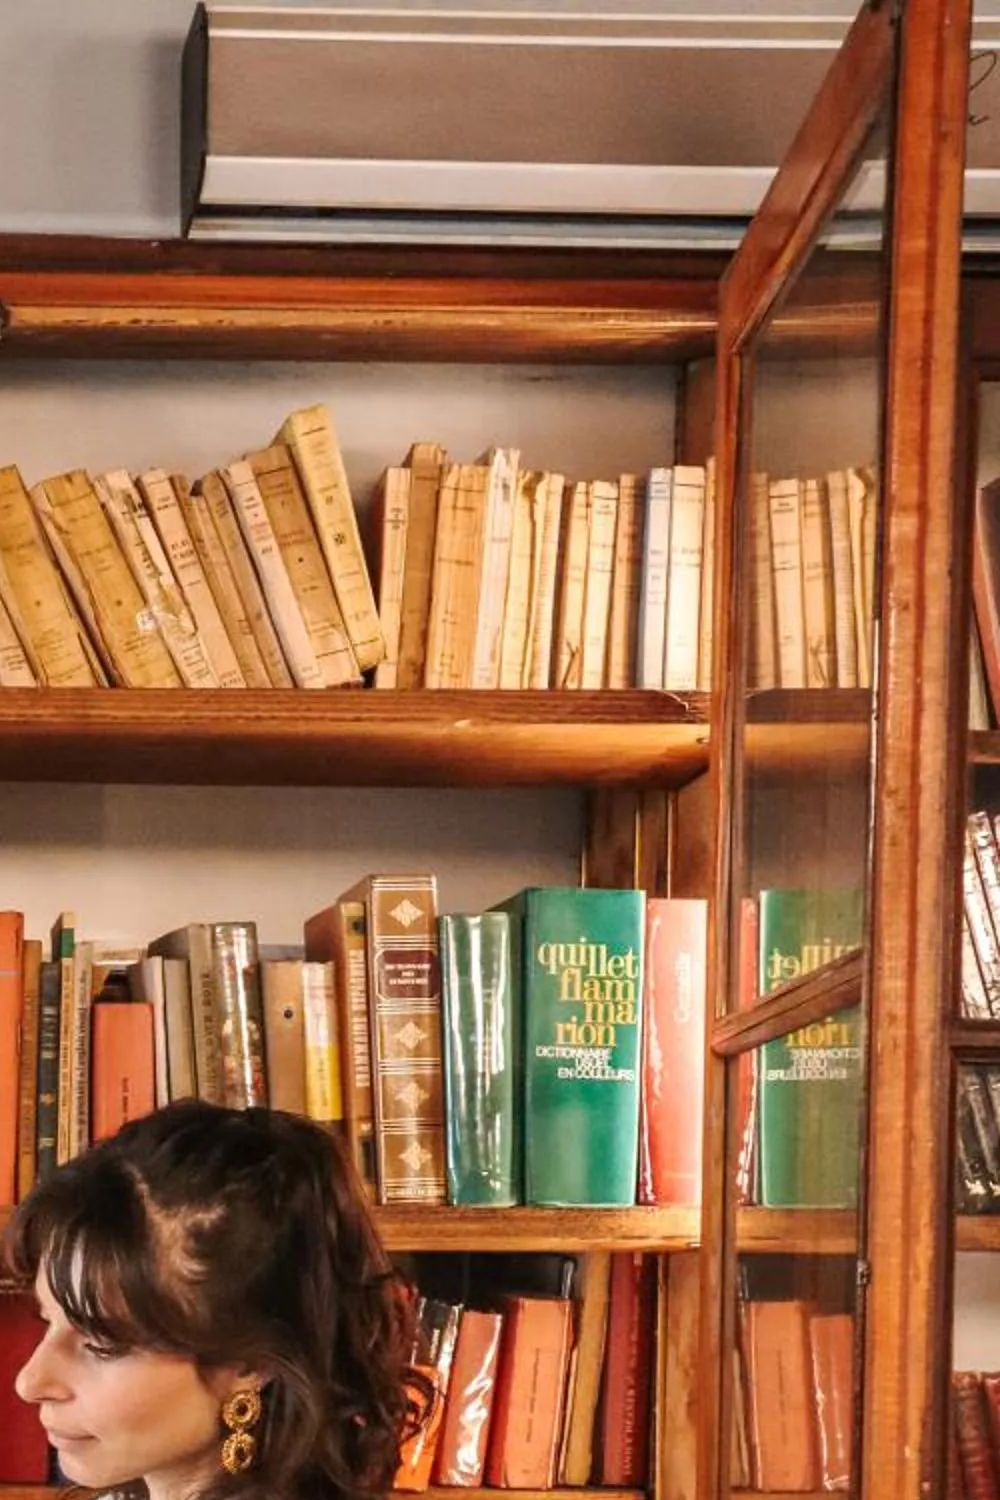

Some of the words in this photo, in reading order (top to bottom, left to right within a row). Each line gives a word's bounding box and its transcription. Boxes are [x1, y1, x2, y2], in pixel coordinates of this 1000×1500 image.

[538, 936, 639, 976] quillet
[560, 967, 635, 1001] flam
[584, 1001, 637, 1025] ma
[556, 1015, 617, 1047] rion
[535, 1045, 613, 1059] DICTIONNAIRE
